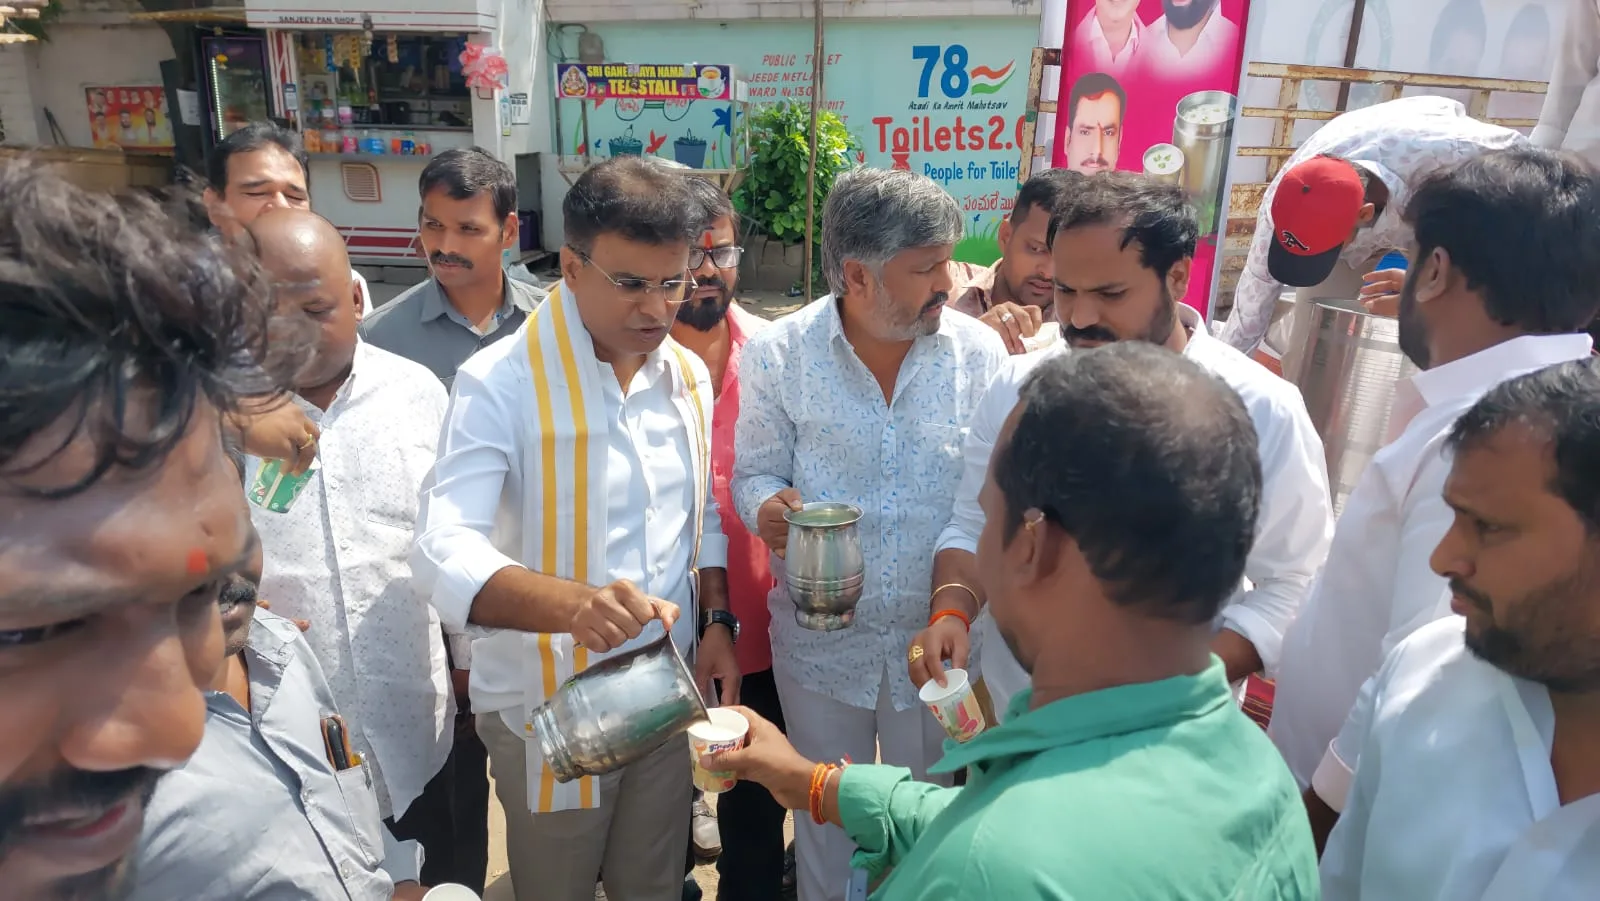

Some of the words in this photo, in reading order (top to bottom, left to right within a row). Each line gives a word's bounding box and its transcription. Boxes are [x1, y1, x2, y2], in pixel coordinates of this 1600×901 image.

[316, 16, 333, 24] PAN
[762, 54, 797, 66] PUBLIC
[804, 54, 843, 66] TET
[586, 65, 602, 78] SRI
[604, 65, 656, 78] GANEAYA
[658, 66, 697, 78] NAMAA
[912, 44, 970, 98] 78
[638, 79, 679, 96] STALL
[749, 86, 777, 97] WARD
[908, 101, 930, 110] Azadi
[933, 102, 942, 110] Ka
[944, 100, 964, 110] Amrit
[967, 100, 1008, 110] Mahotsav
[924, 162, 963, 186] People
[967, 164, 987, 180] for
